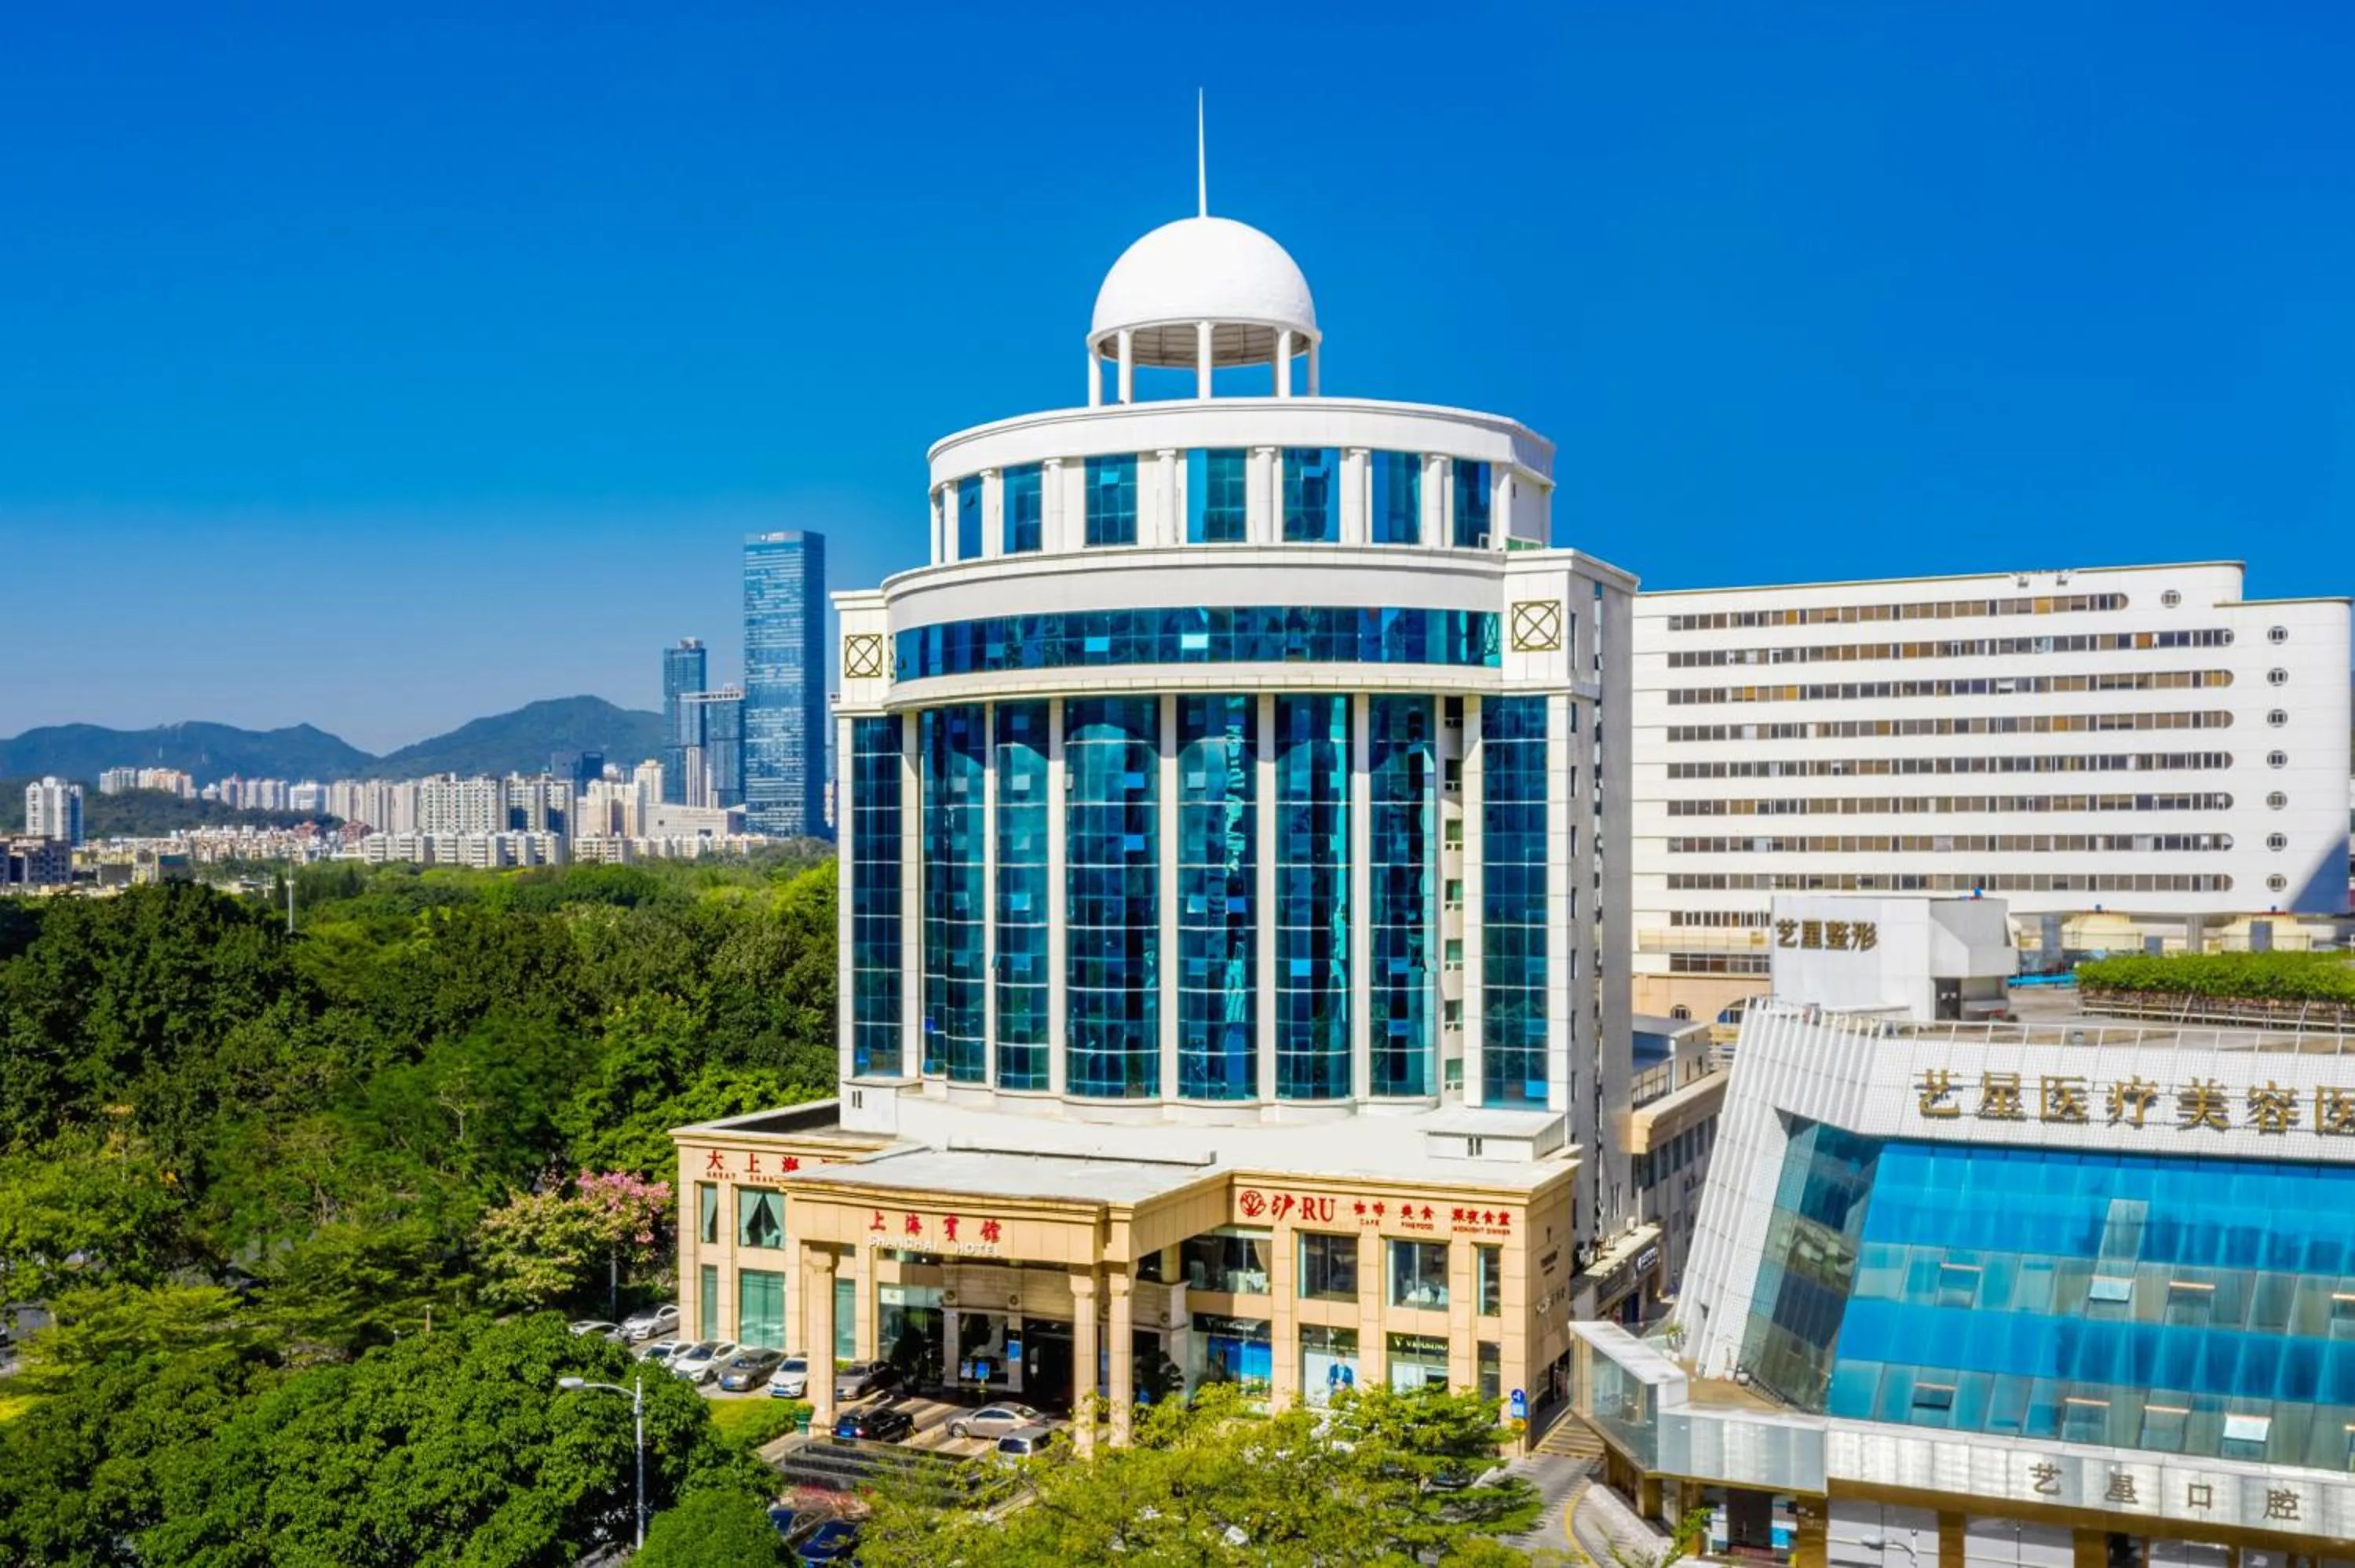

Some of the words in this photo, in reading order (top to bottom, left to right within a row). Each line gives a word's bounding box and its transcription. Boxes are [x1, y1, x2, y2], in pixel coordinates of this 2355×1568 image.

[1776, 918, 1878, 952] 艺星整形
[868, 1235, 938, 1253] SHANGHAI
[954, 1242, 1003, 1256] HOTEL
[2028, 1462, 2302, 1522] 艺星口腔
